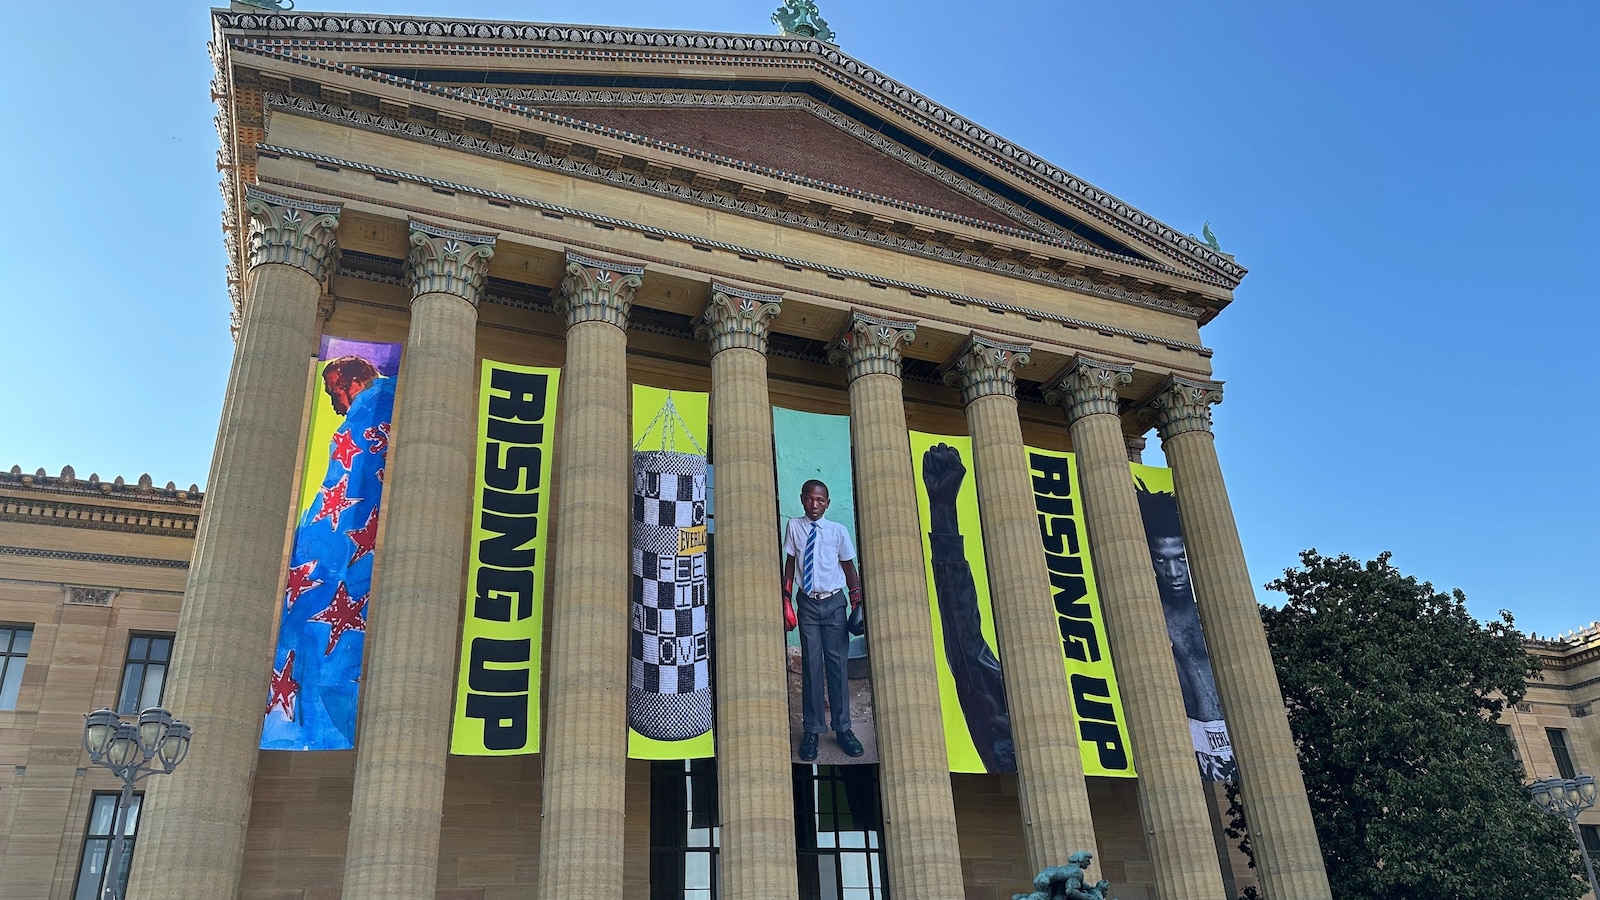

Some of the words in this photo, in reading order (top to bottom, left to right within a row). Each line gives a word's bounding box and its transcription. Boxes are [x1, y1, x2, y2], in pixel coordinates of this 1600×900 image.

[474, 367, 548, 622] RISING
[1029, 452, 1101, 663] RISING
[1070, 673, 1128, 770] UP
[465, 637, 531, 751] UP
